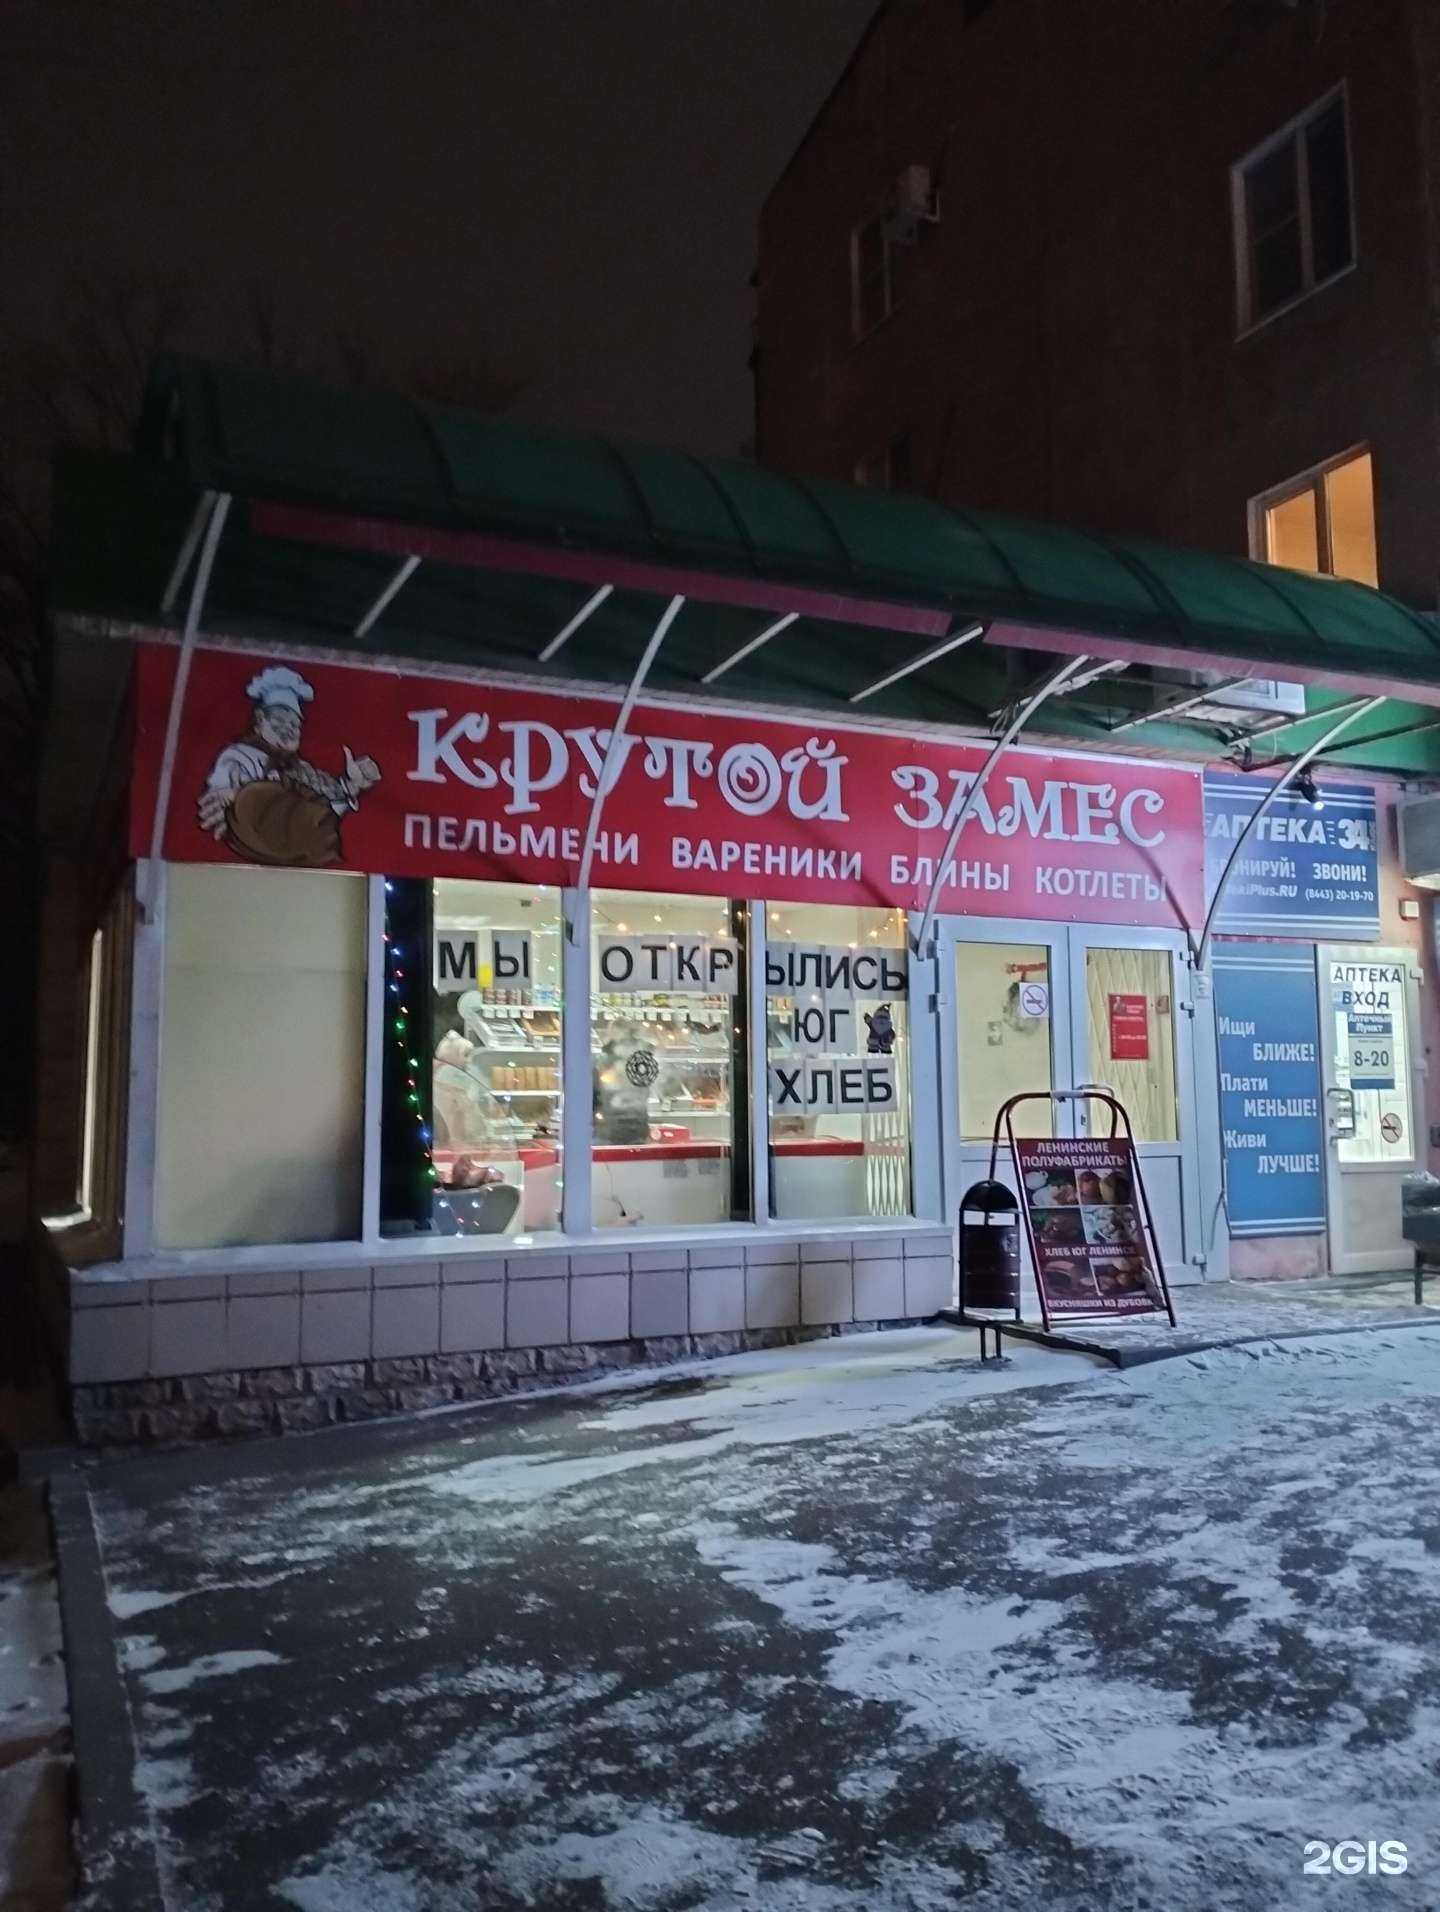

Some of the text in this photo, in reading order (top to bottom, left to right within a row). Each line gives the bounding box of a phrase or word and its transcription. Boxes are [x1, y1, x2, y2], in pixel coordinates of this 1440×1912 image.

[407, 708, 1167, 848] КРУТОЙ ЗАМЕС
[1210, 813, 1327, 845] АПТЕКА
[403, 814, 1166, 902] ПЕЛЬМЕНИ ВАРЕНИКИ БЛИНЫ КОТЛЕТЫ
[1211, 857, 1367, 882] РОНИРУЙ! ЗВОНИ!
[439, 940, 530, 979] МЫ
[1333, 966, 1402, 983] АПТЕКА
[1341, 990, 1390, 1009] ВХОД
[794, 1008, 850, 1043] ЮГ
[1219, 1016, 1255, 1037] Ищи
[1355, 1022, 1384, 1034] Пункт
[1253, 1043, 1315, 1062] БЛИЖЕ!
[1353, 1050, 1390, 1067] 8-20
[775, 1068, 893, 1104] ХЛЕБ
[1221, 1073, 1268, 1092] Плати
[1244, 1098, 1318, 1118] МЕНЬШЕ!
[1036, 1141, 1110, 1153] ЛЕНИНСКИЕ
[1224, 1129, 1267, 1149] Живи
[1257, 1154, 1320, 1174] ЛУЧШЕ!
[1044, 1246, 1070, 1257] ХЛЕБ
